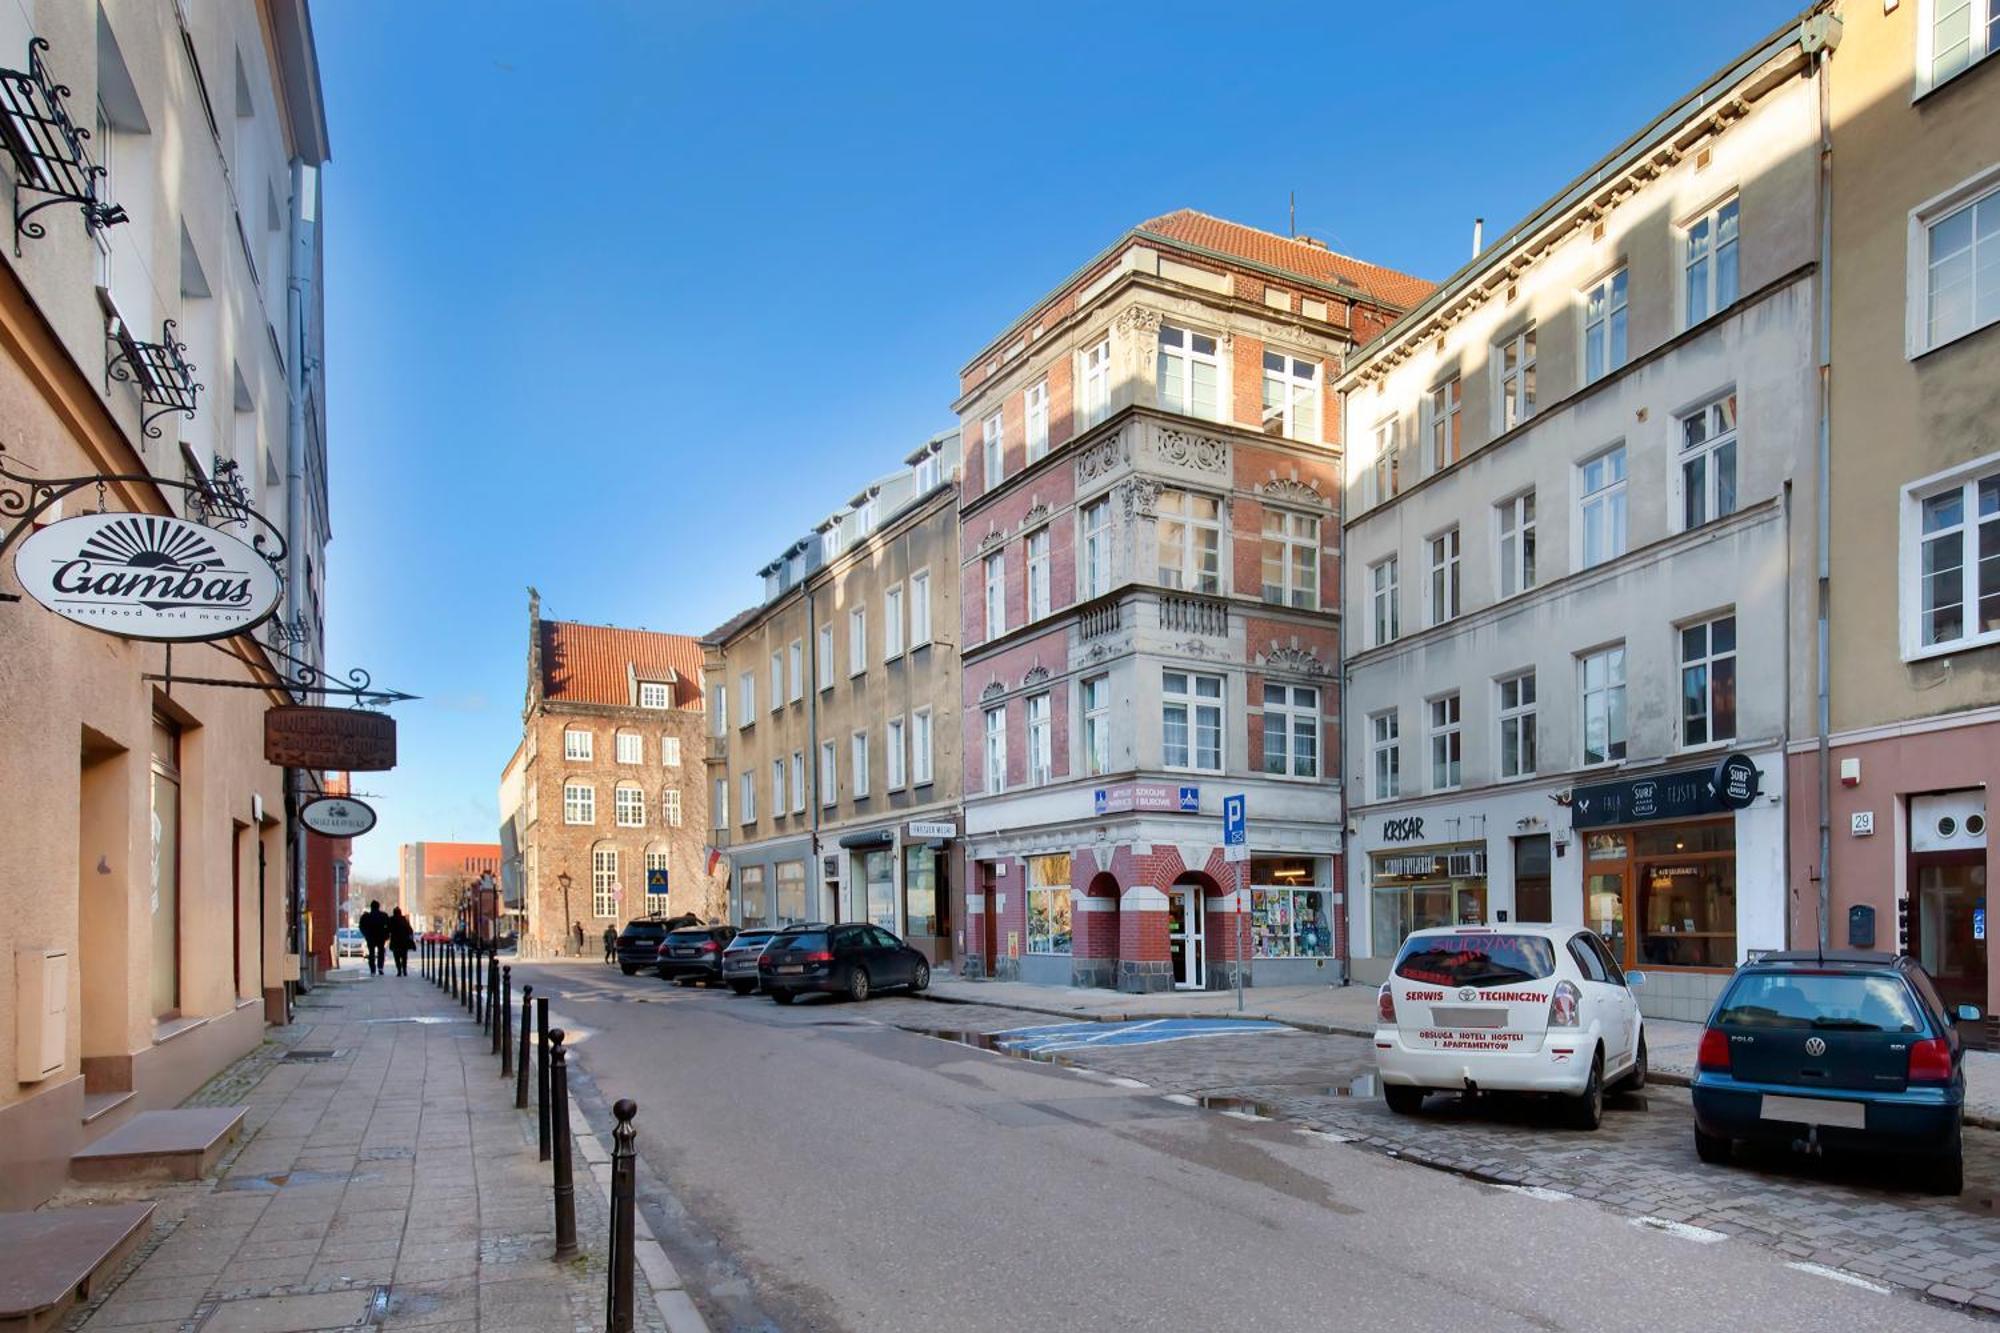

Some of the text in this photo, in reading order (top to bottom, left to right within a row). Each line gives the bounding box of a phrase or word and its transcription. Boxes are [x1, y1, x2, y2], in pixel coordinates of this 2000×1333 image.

[52, 560, 252, 603] Gambas
[67, 607, 241, 622] seafood and meat
[1730, 768, 1748, 782] SURF
[1634, 786, 1653, 799] SURF
[1228, 800, 1241, 831] P
[1855, 814, 1869, 829] 29
[1383, 817, 1425, 842] KRISAR
[1406, 991, 1549, 1003] SERWIS TECHNICZNY
[1460, 1032, 1486, 1041] HOTELI
[1492, 1033, 1524, 1041] HOSTELI
[1731, 1035, 1754, 1043] POLO
